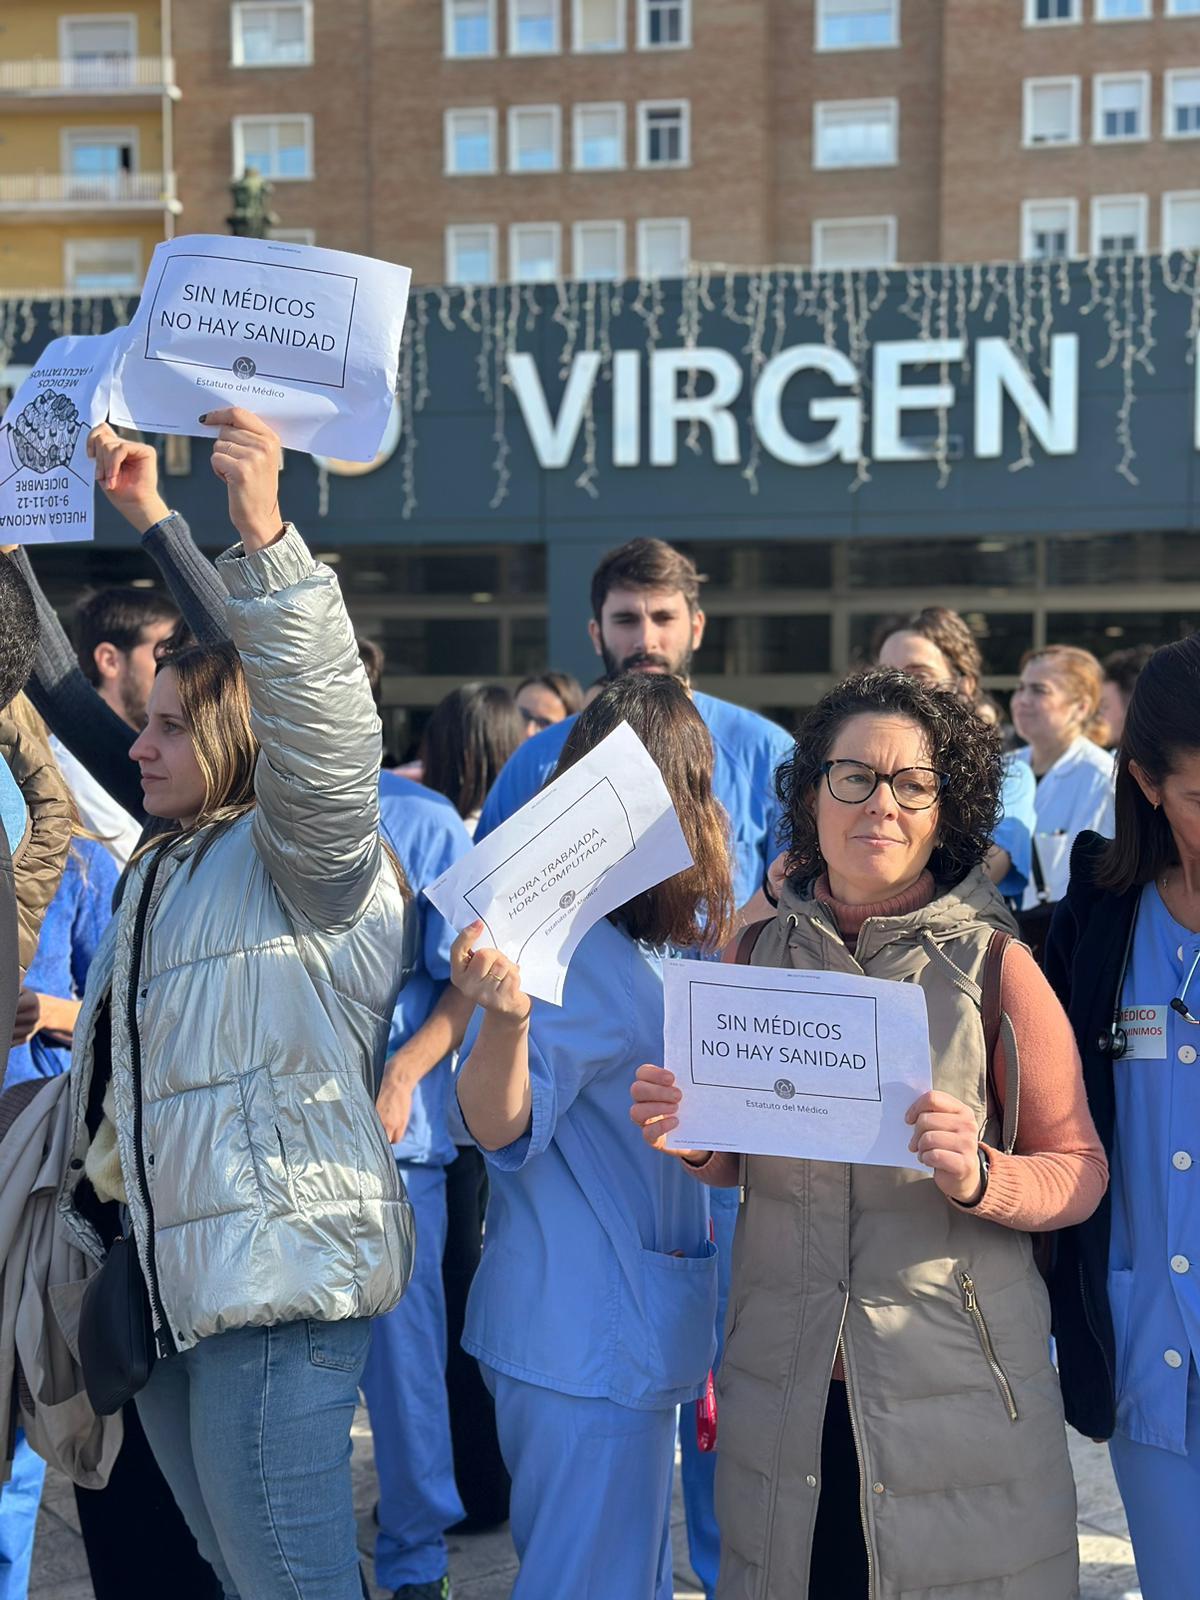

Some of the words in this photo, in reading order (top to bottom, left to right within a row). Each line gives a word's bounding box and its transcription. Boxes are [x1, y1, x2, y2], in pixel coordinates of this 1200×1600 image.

[183, 284, 216, 304] SIN
[222, 287, 316, 319] MÉDICOS
[160, 310, 192, 330] NO
[198, 315, 240, 338] HAY
[243, 322, 336, 352] SANIDAD
[37, 379, 79, 389] MÉDICOS
[195, 377, 234, 391] Estatuto
[235, 382, 250, 392] del
[251, 384, 285, 399] Médico
[505, 332, 1080, 469] VIRGEN
[15, 477, 69, 492] DICIEMBRE
[17, 494, 69, 509] 9-10-11-12
[0, 513, 46, 527] NACIONA
[49, 511, 87, 525] HUELGA
[508, 877, 541, 904] HORA
[540, 827, 600, 877] TRABAJADA
[508, 891, 539, 920] HORA
[540, 837, 608, 893] COMPUTADA
[544, 911, 567, 936] Estatuto
[717, 1013, 747, 1032] SIN
[753, 1015, 842, 1041] MÉDICOS
[701, 1039, 730, 1057] NO
[736, 1043, 774, 1061] HAY
[779, 1047, 866, 1070] SANIDAD
[746, 1100, 781, 1111] Estatuto
[782, 1103, 796, 1112] del
[796, 1104, 829, 1116] Médico
